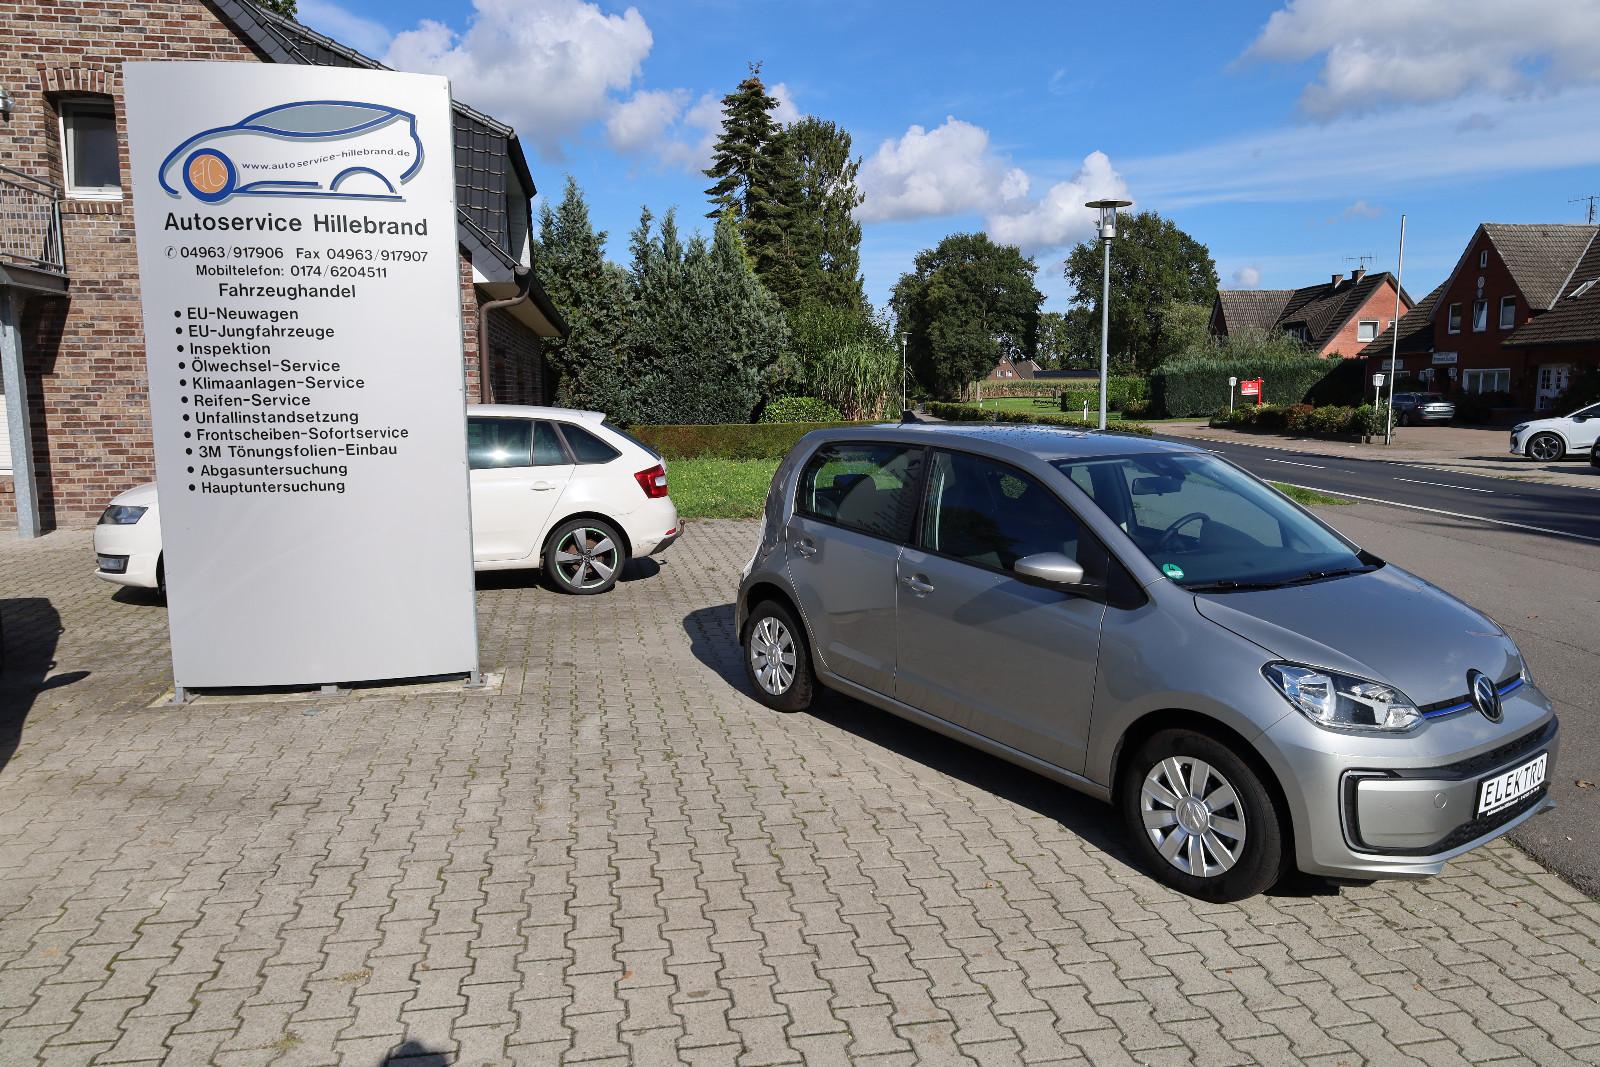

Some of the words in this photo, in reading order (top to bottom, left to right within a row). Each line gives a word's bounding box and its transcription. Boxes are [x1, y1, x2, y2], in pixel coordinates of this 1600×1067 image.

[242, 148, 410, 170] www.autoservice-hillebrand.de
[165, 212, 302, 231] Autoservice
[314, 214, 427, 236] Hillebrand
[181, 246, 283, 259] 04963/917906
[296, 248, 320, 259] Fax
[327, 248, 428, 262] 04963/917907
[196, 265, 284, 276] Mobiltelefon:
[291, 265, 386, 278] 0174/6204511
[219, 283, 355, 300] Fahrzeughandel
[187, 307, 298, 322] EU-Neuwagen
[189, 325, 334, 340] EU-Jungfahrzeuge
[190, 342, 270, 357] Inspektion
[192, 356, 340, 372] Ölwechsel-Service
[193, 376, 364, 391] Klimaanlagen-Service
[194, 394, 310, 407] Reifen-Service
[196, 411, 358, 425] Unfallinstandsetzung
[197, 426, 408, 441] Frontscheiben-Sofortservice
[199, 446, 221, 458] 3M
[228, 444, 397, 460] Tönungsfolien-Einbau
[201, 463, 347, 478] Abgasuntersuchung
[202, 480, 345, 495] Hauptuntersuchung
[1484, 759, 1544, 807] ELEKTRO
